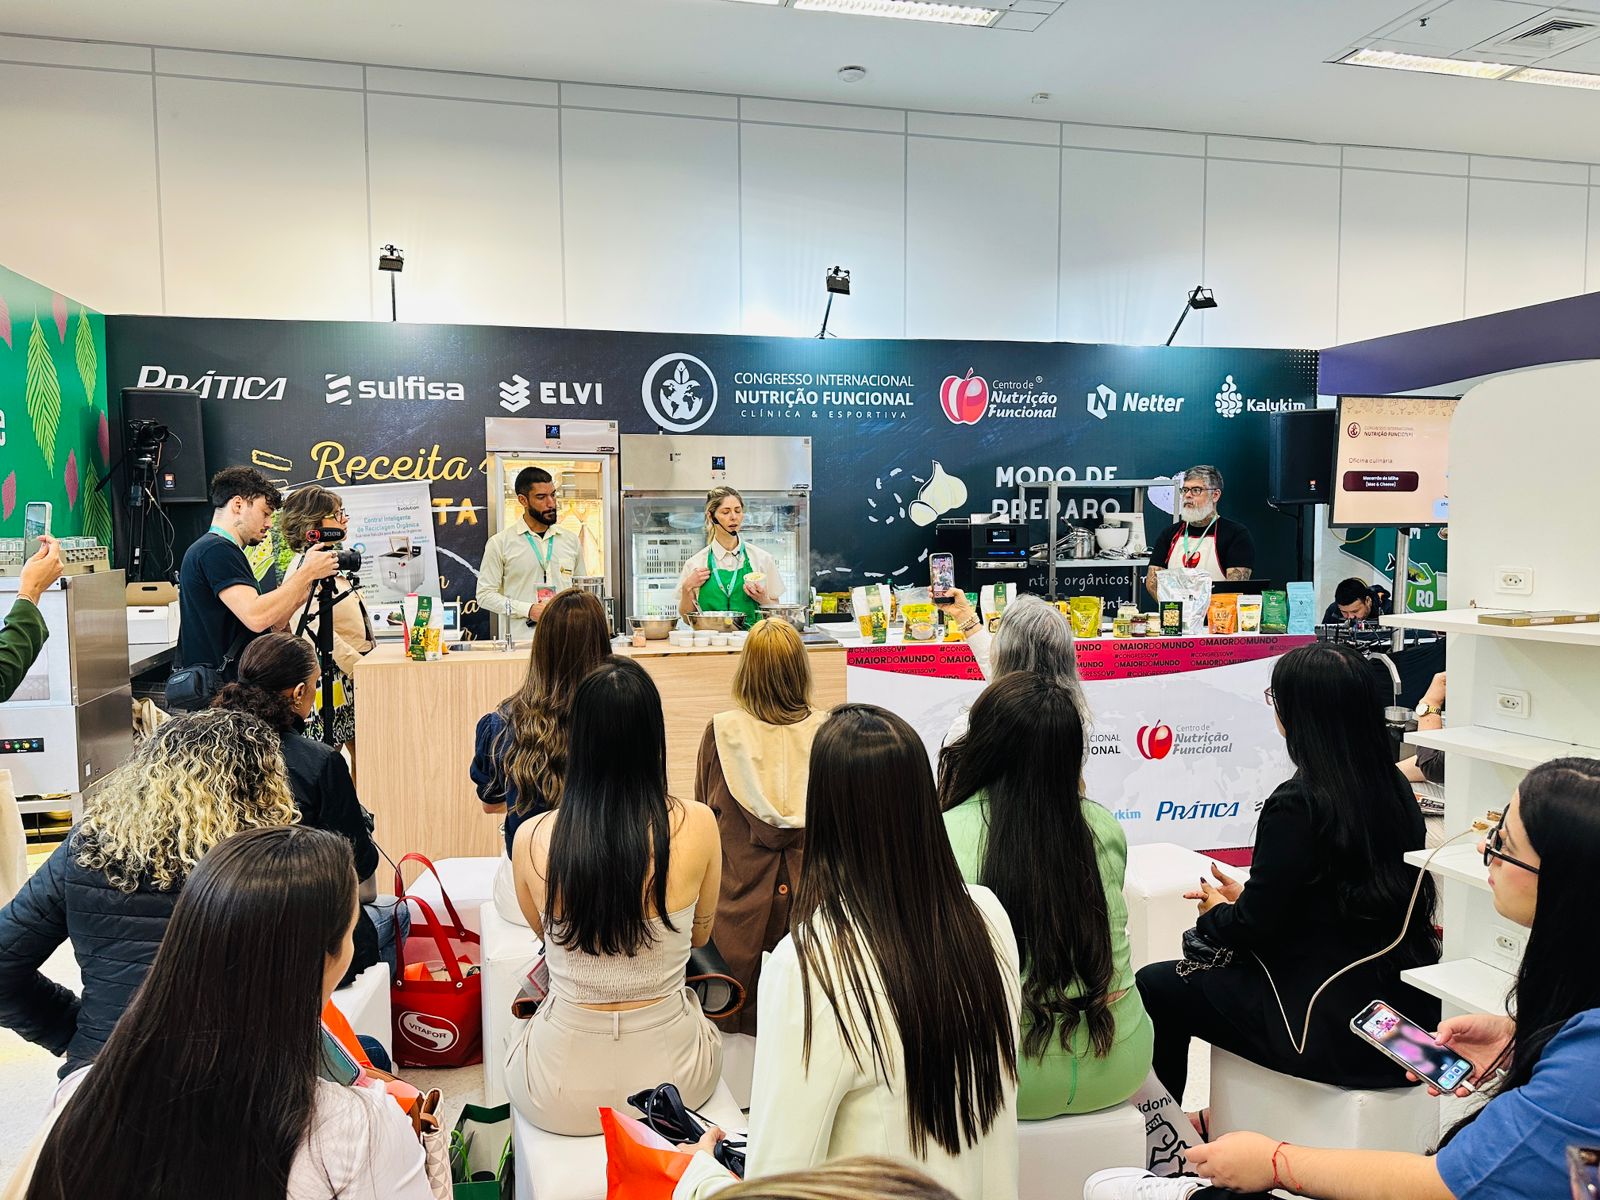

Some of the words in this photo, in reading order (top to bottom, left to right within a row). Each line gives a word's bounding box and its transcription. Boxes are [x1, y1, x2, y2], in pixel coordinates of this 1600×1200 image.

[734, 372, 813, 385] CONGRESSO
[816, 374, 915, 387] INTERNACIONAL
[992, 380, 1022, 389] Centro
[1023, 380, 1034, 389] de
[358, 375, 465, 401] sulfisa
[540, 381, 603, 405] ELVI
[735, 388, 819, 408] NUTRIÇÃO
[823, 391, 914, 406] FUNCIONAL
[990, 390, 1058, 407] Nutrição
[1122, 392, 1185, 412] Netter
[1246, 398, 1306, 412] Kalykim
[740, 409, 801, 418] CLÍNICA
[829, 410, 907, 419] ESPORTIVA
[987, 404, 1057, 418] Funcional
[310, 441, 473, 485] Receita
[995, 466, 1077, 487] MODO
[1064, 573, 1133, 592] orgânicos,
[1113, 641, 1195, 651] OMAIORDOMUNDO
[848, 655, 936, 665] OMAIORDOMUNDO
[1176, 724, 1200, 732] Centro
[1201, 723, 1211, 731] de
[1174, 732, 1229, 744] Nutrição
[1172, 743, 1233, 755] Funcional
[1156, 800, 1240, 822] PRÁTICA
[408, 1022, 447, 1039] VITAFOR
